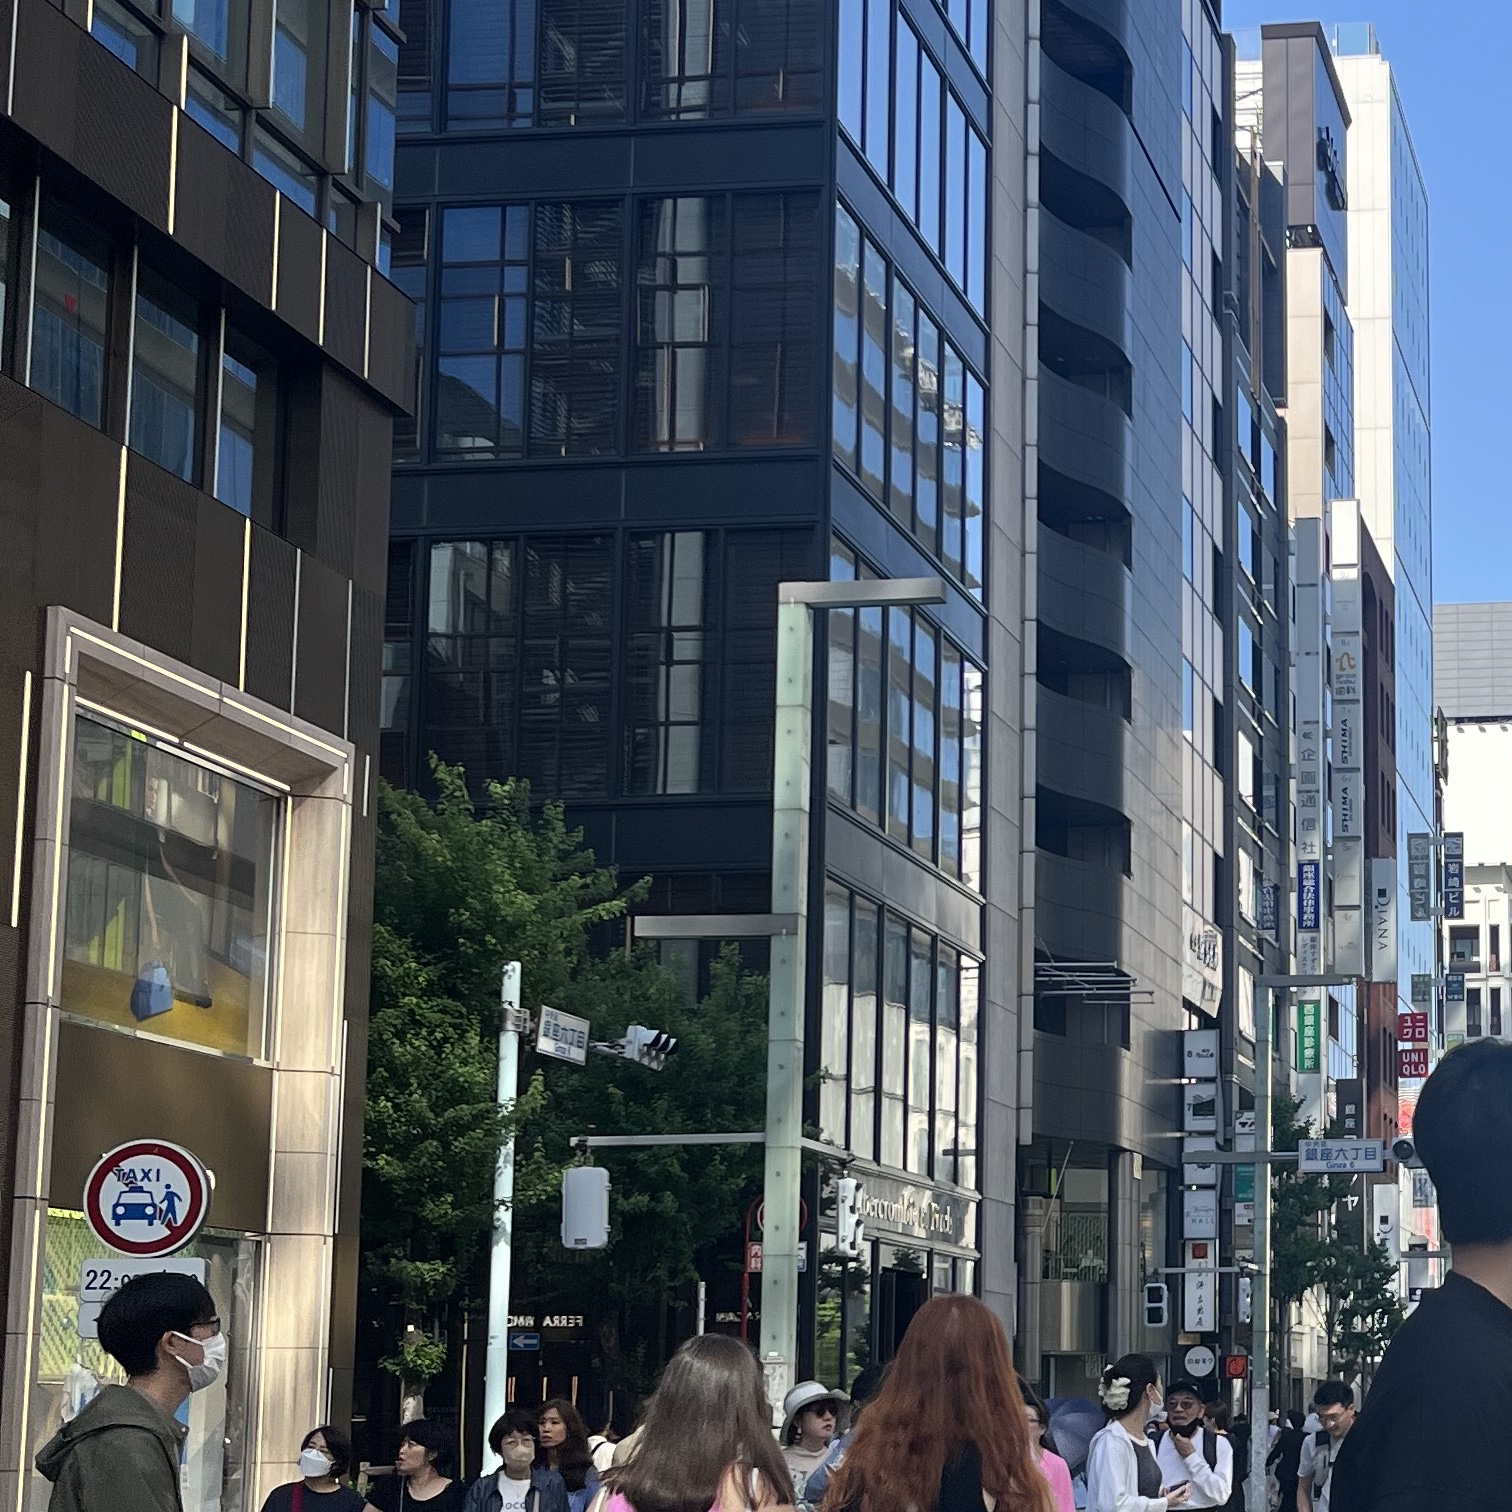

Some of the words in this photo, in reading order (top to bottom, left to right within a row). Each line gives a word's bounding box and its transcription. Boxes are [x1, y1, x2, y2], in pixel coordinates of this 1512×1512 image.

[1341, 786, 1349, 833] SHIMA
[1448, 862, 1460, 918] 岩崎ビル
[1377, 897, 1391, 951] DIANA
[1402, 1015, 1426, 1027] ユニ
[1402, 1028, 1426, 1039] クロ
[1402, 1051, 1425, 1063] UNI
[1402, 1063, 1426, 1076] QLO
[1305, 1147, 1377, 1161] 銀座六丁目
[1326, 1161, 1347, 1169] Ginza
[115, 1168, 161, 1183] TAXI
